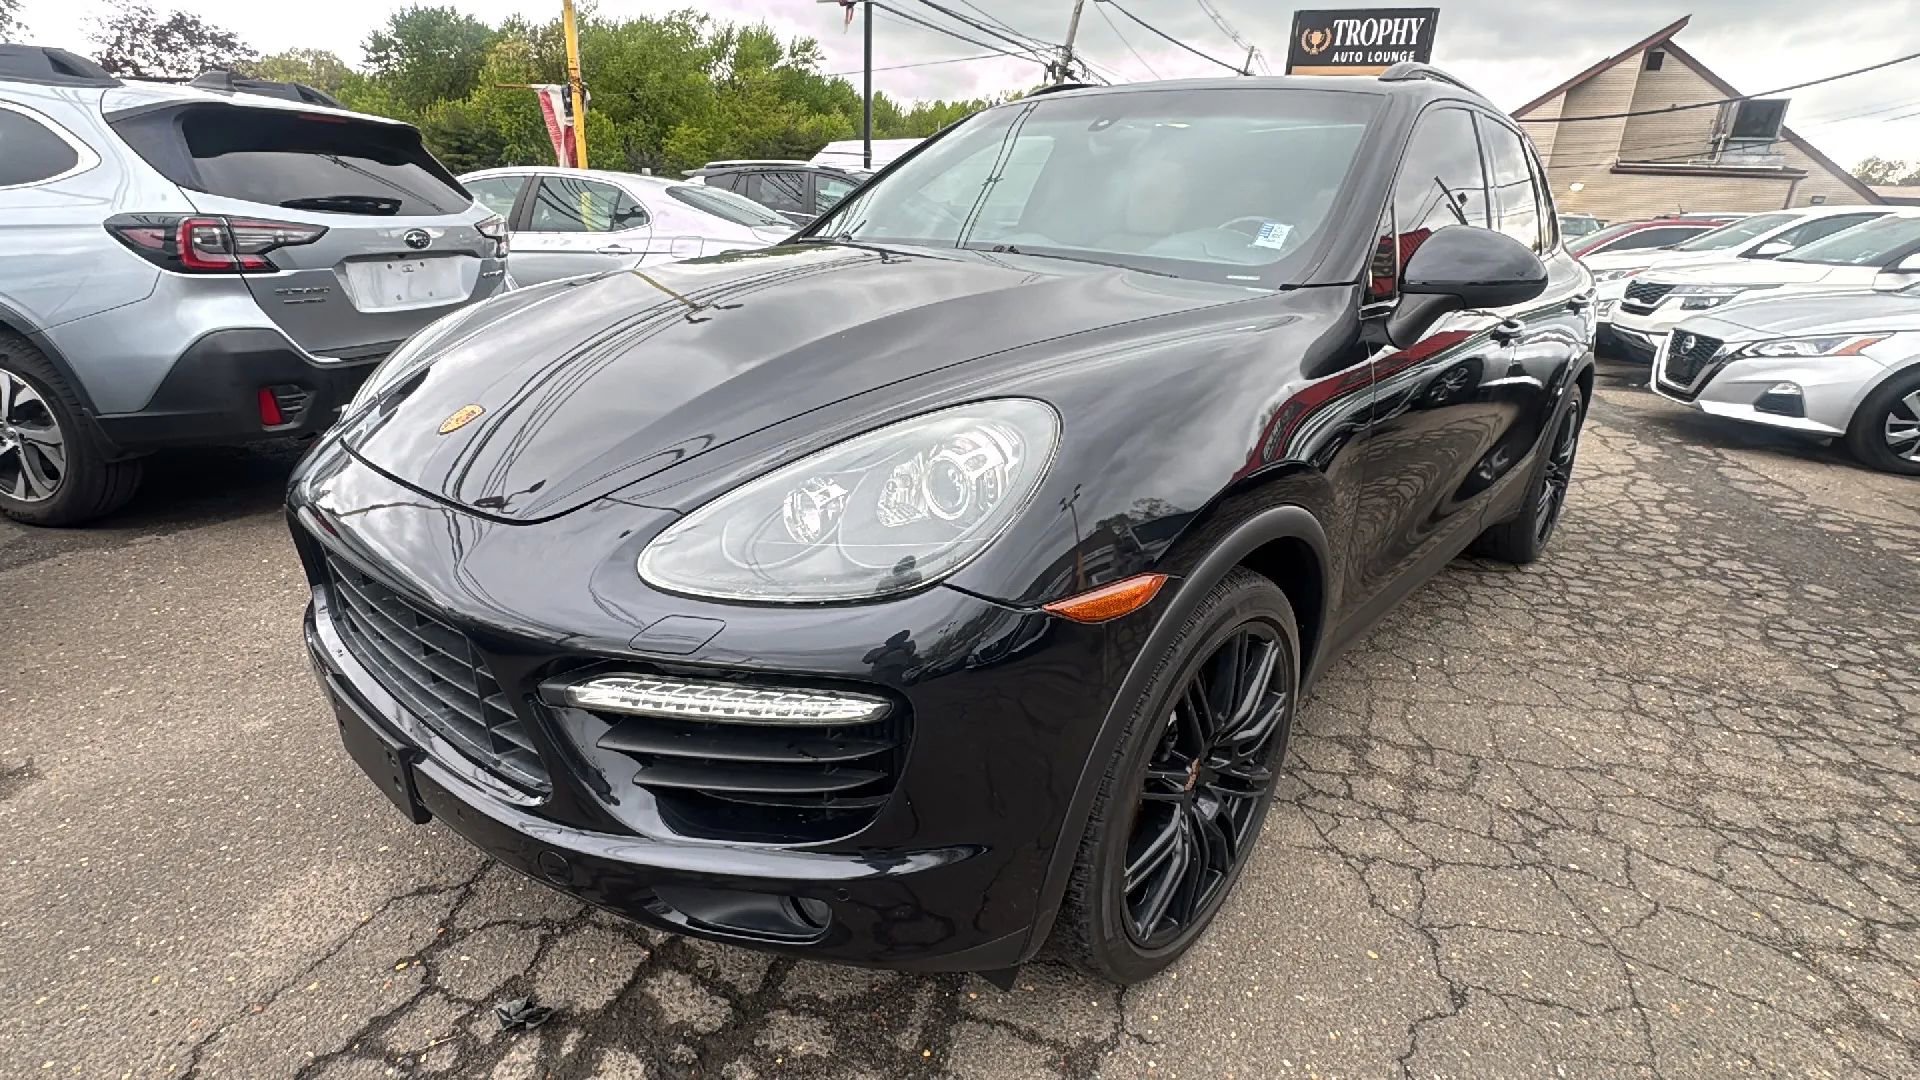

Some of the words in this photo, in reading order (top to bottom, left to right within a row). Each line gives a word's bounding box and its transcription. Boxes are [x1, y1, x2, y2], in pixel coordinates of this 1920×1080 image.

[1333, 17, 1426, 46] TROPHY
[1332, 51, 1362, 63] AUTO
[1367, 50, 1416, 63] LOUNGE
